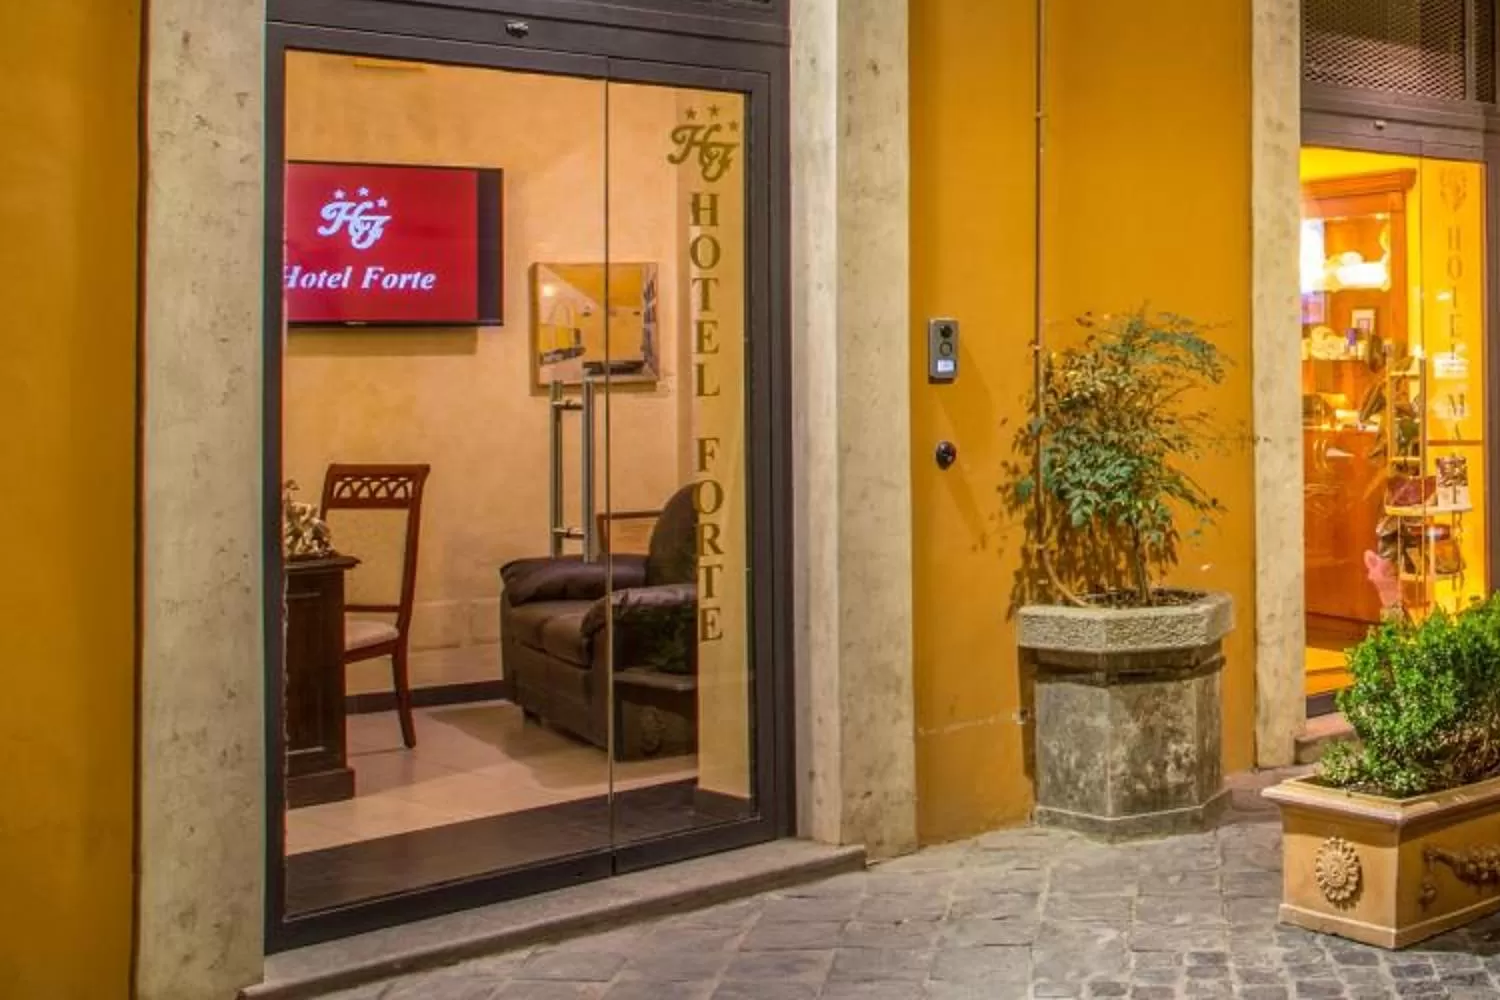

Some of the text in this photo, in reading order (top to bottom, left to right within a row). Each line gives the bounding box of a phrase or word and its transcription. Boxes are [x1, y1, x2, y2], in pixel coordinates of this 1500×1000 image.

[284, 266, 437, 290] Hotel Forte
[690, 192, 724, 642] HOTEL FORTE
